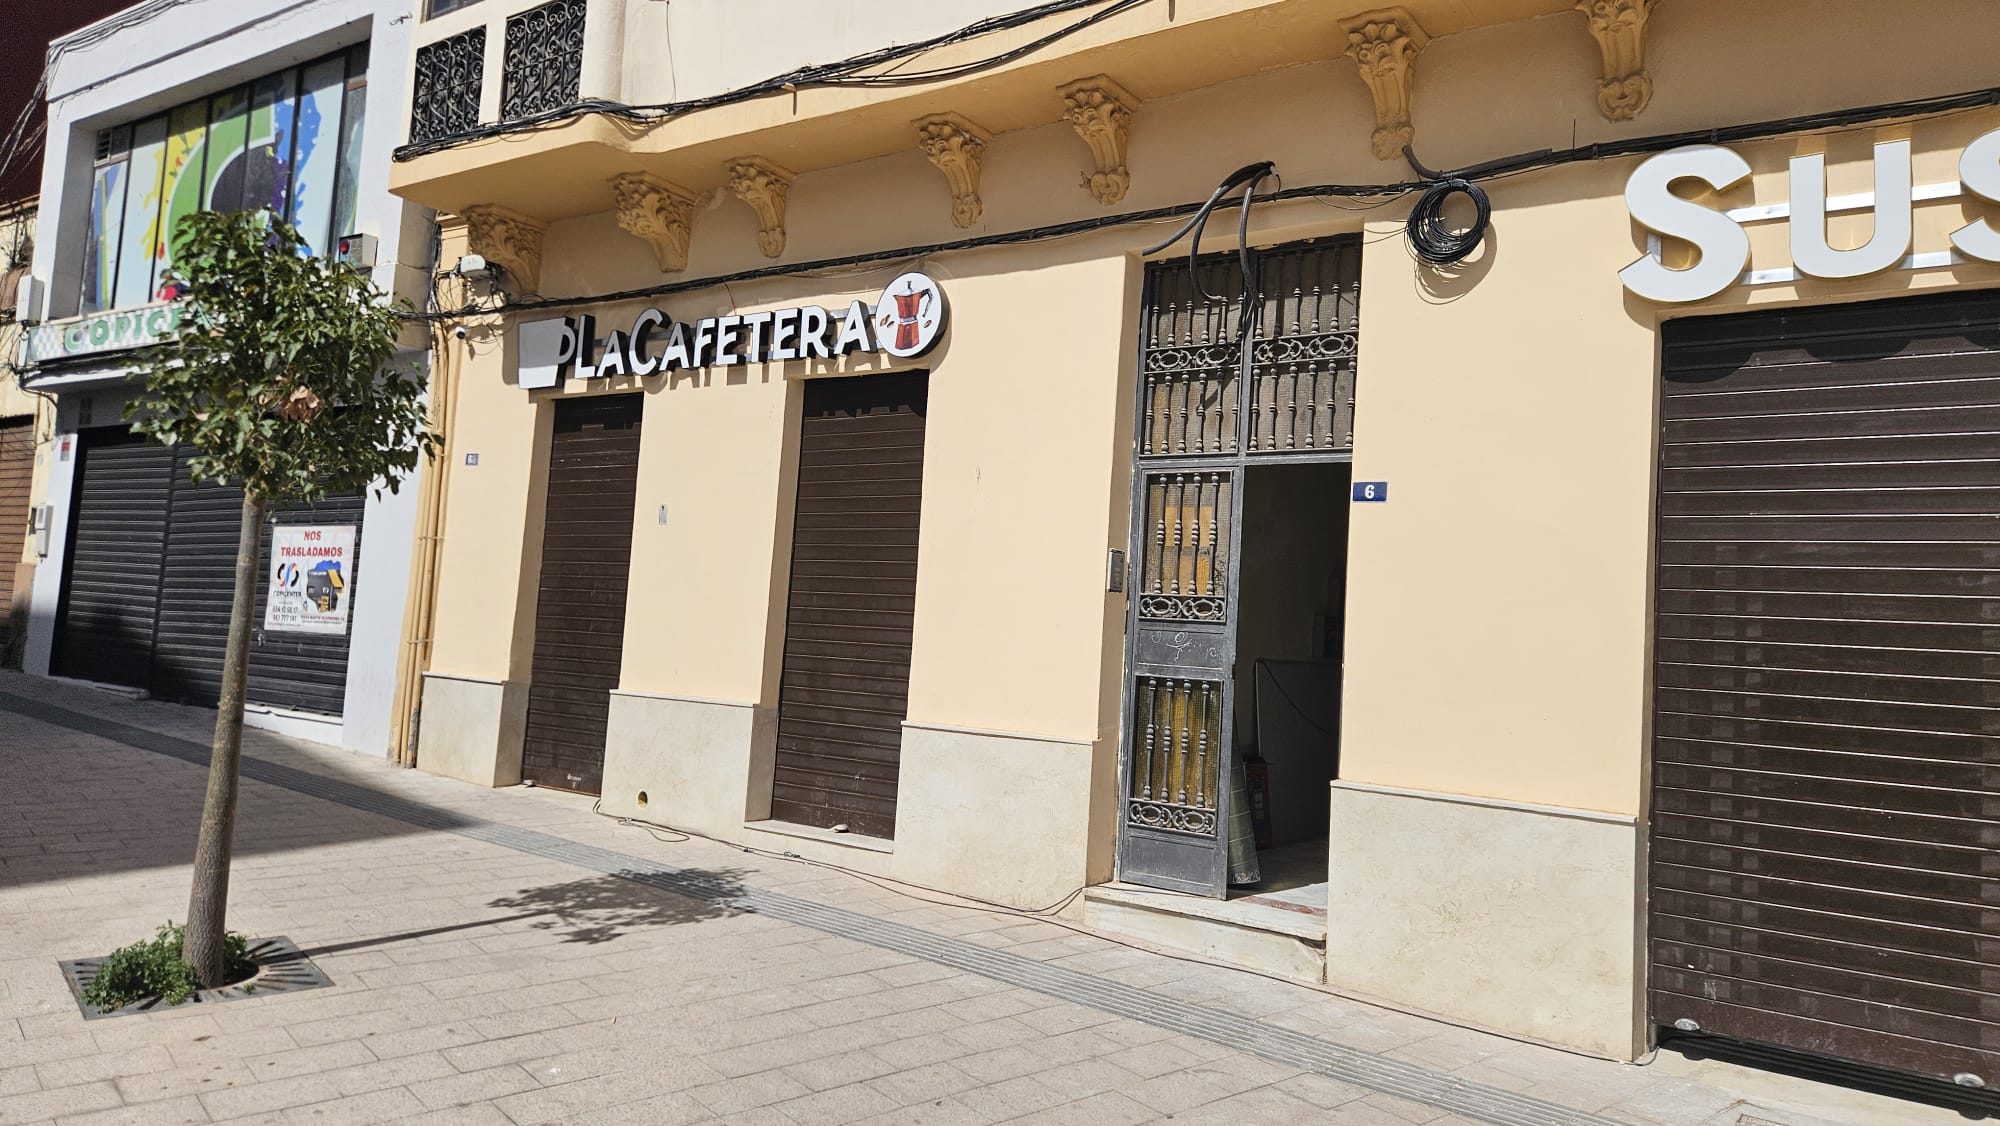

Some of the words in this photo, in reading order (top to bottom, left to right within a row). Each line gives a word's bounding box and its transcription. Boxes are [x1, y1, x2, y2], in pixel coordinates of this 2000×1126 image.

[1364, 484, 1375, 499] 6
[303, 530, 322, 541] NOS
[280, 546, 343, 557] TRASLADAMOS
